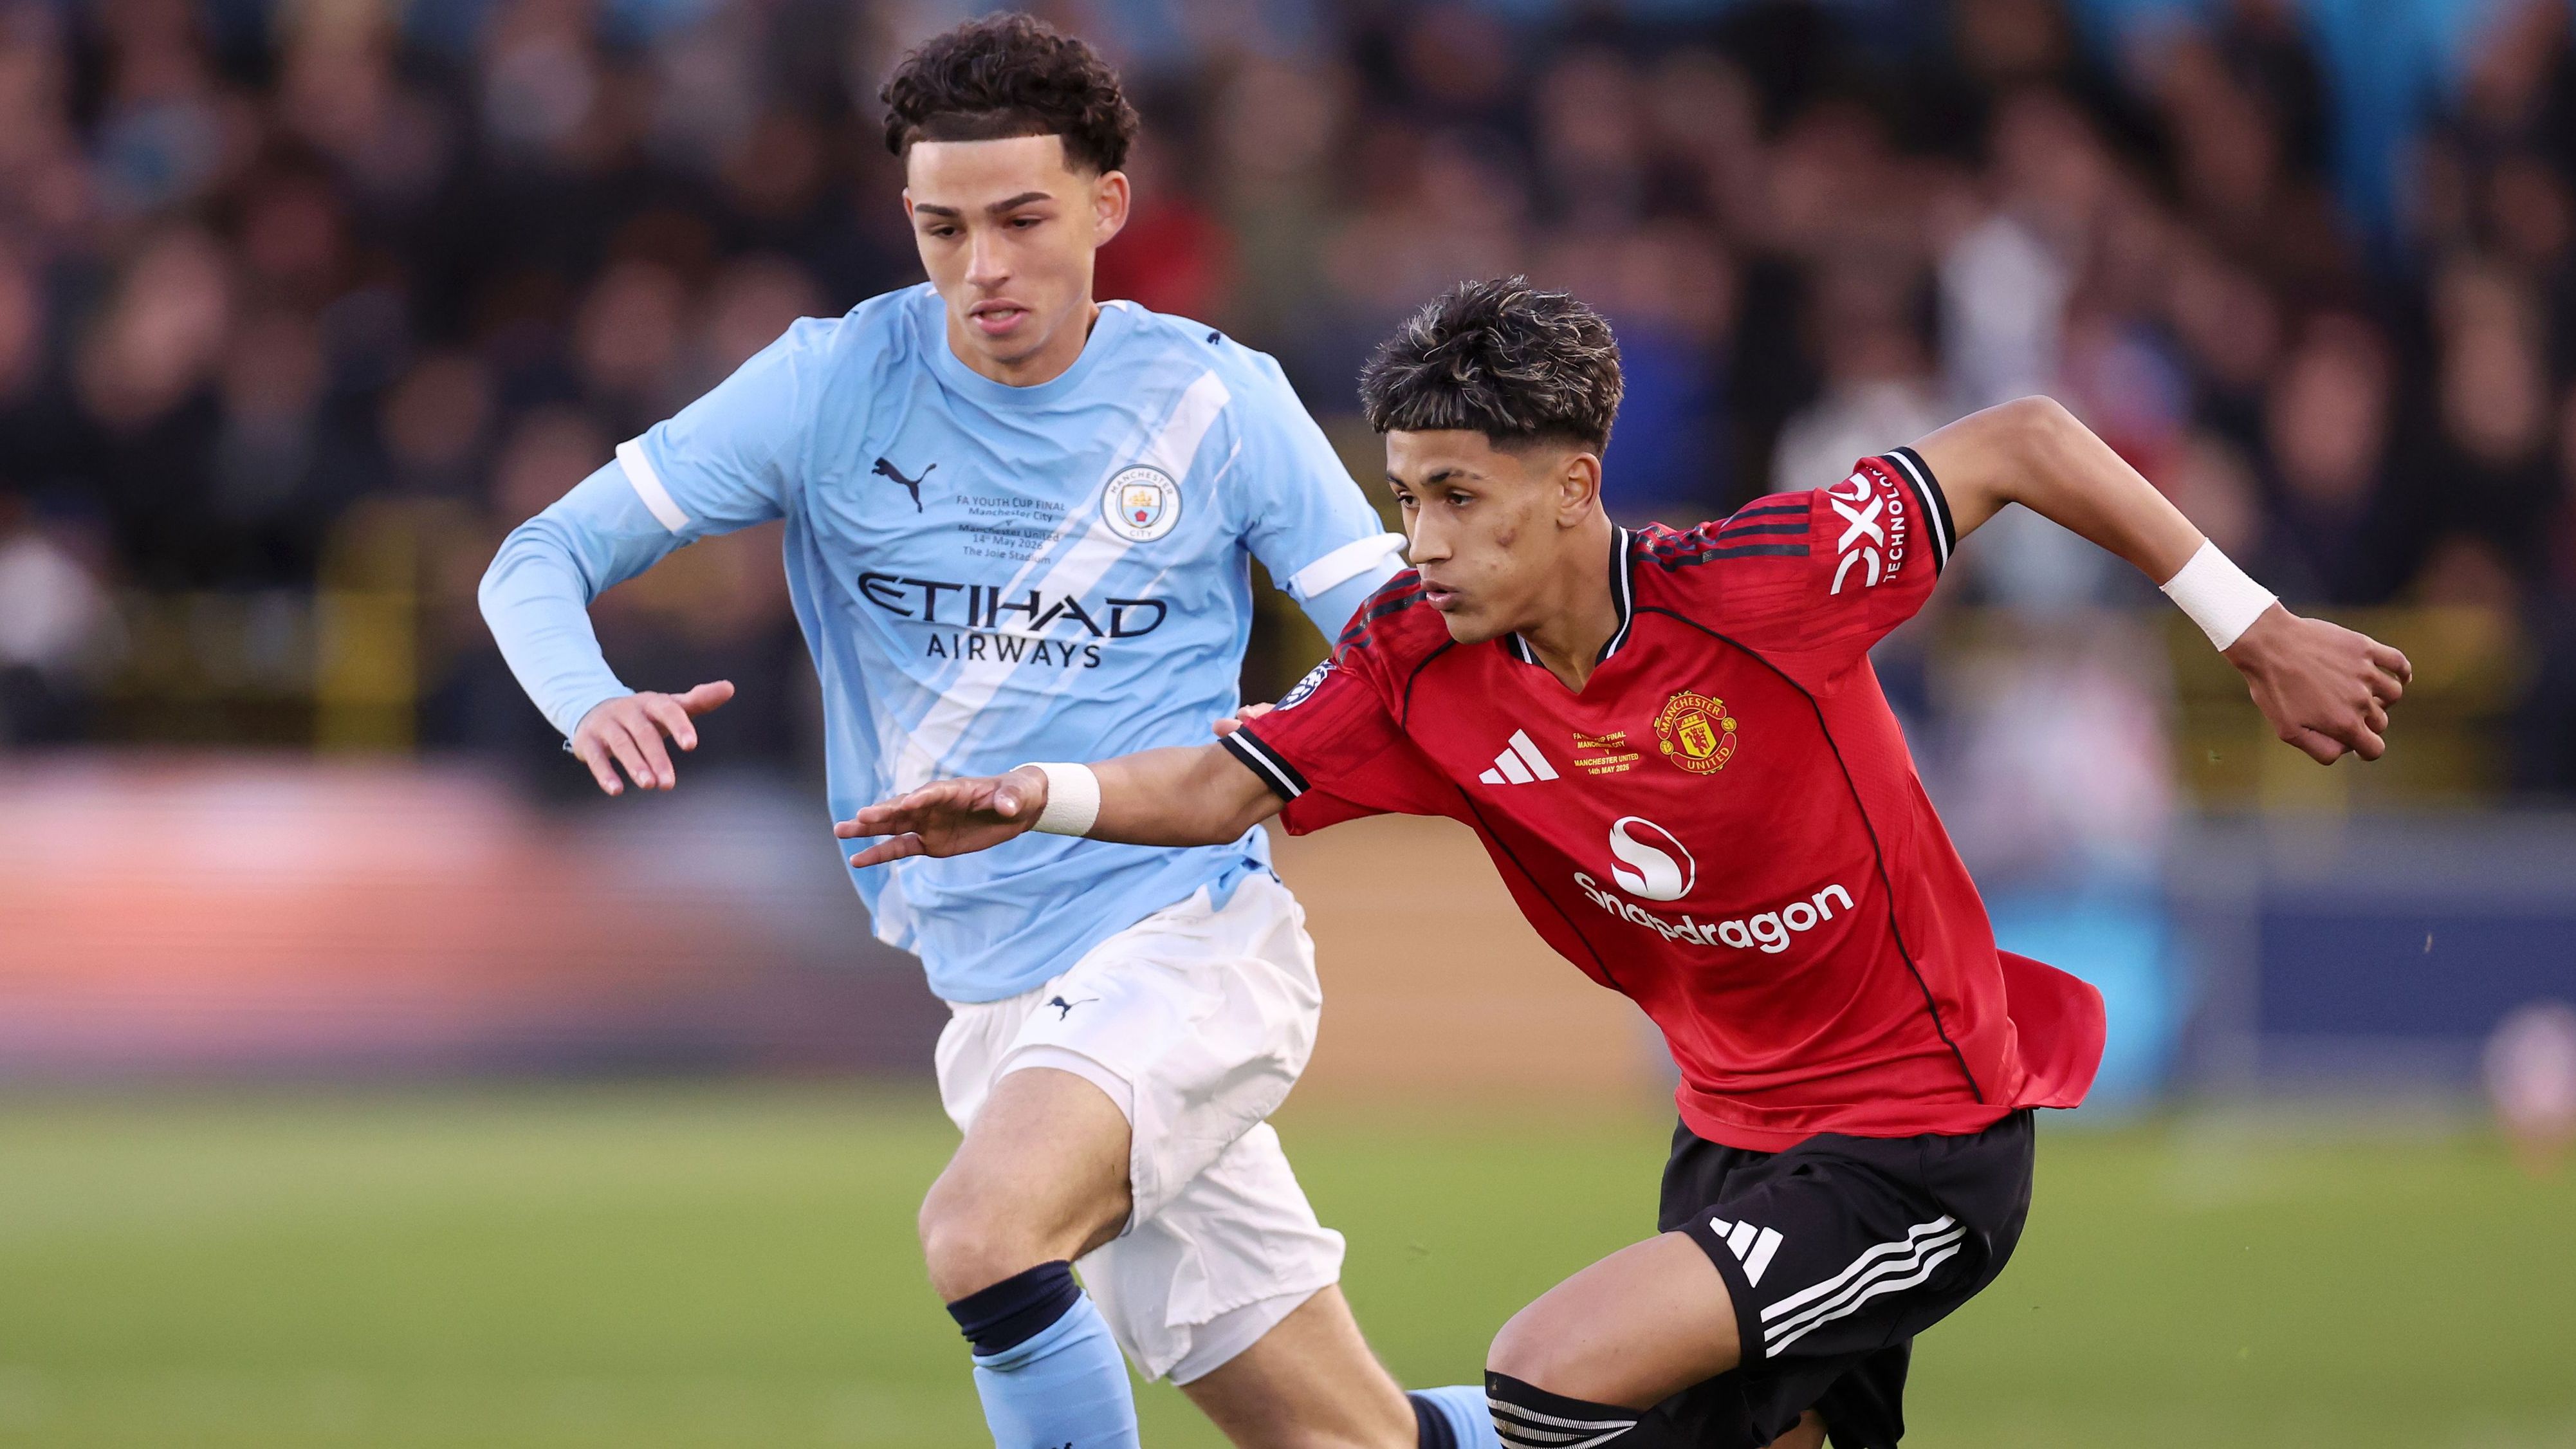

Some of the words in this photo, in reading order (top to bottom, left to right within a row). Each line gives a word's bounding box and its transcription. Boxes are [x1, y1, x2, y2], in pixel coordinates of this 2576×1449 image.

[1110, 471, 1173, 495] MANCHESTER
[957, 495, 969, 505] FA
[972, 497, 1009, 507] YOUTH
[1013, 497, 1033, 507] CUP
[1036, 500, 1065, 511] FINAL
[969, 507, 1030, 519] Manchester
[1033, 511, 1053, 522] City
[958, 524, 1020, 537] Manchester
[1024, 529, 1059, 542] United
[993, 535, 1016, 548] May
[1018, 538, 1044, 549] 2026
[963, 546, 983, 557] The
[1009, 549, 1051, 564] Stadium
[858, 572, 1167, 639] ETIHAD
[926, 633, 1101, 669] AIRWAYS
[1661, 697, 1720, 733] MANCHESTER
[1606, 731, 1626, 741] FINAL
[1574, 756, 1618, 766] MANCHESTER
[1619, 753, 1639, 762] UNITED
[1687, 747, 1729, 770] UNITED
[1601, 766, 1615, 774] MAY
[1616, 764, 1630, 772] 2026
[1574, 872, 1854, 954] Snapdragon
